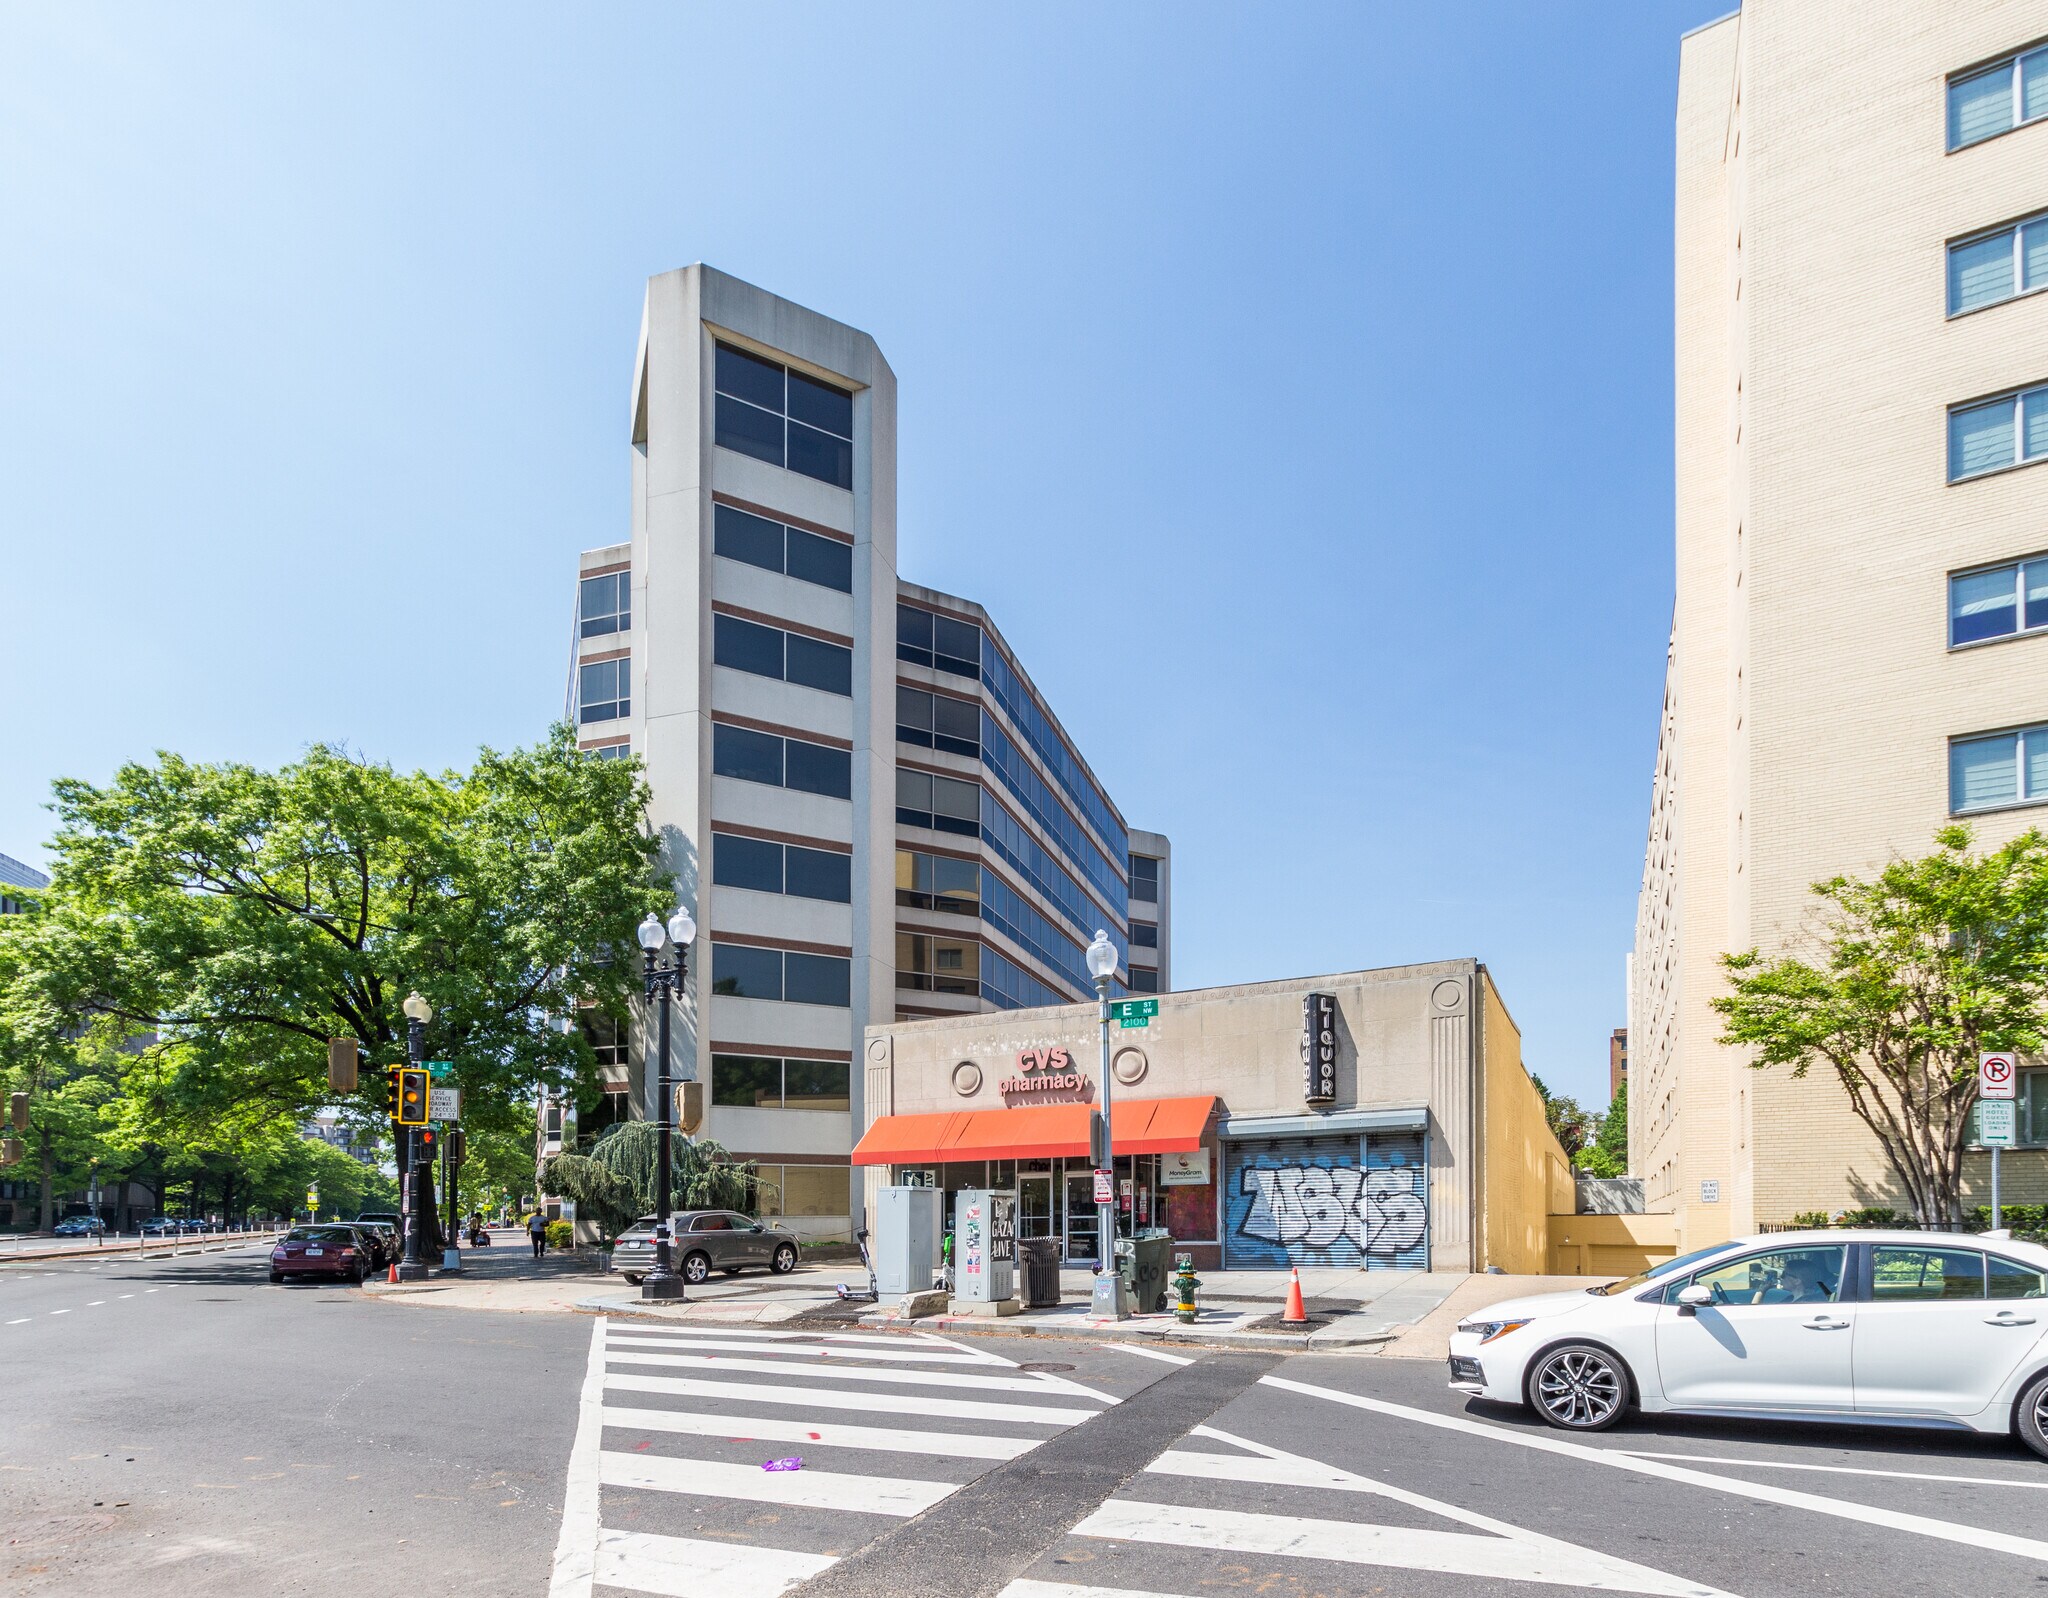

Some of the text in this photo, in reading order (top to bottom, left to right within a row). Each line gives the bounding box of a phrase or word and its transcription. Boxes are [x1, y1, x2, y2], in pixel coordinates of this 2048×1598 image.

[1122, 1003, 1132, 1016] E
[1123, 1017, 1147, 1027] 2100
[1320, 997, 1333, 1096] LIQUOR
[1015, 1045, 1069, 1072] CVS
[998, 1073, 1088, 1097] pharmacy
[1168, 1169, 1202, 1177] MoneyGram
[991, 1220, 1013, 1238] GAZA
[993, 1240, 1011, 1258] LIVE
